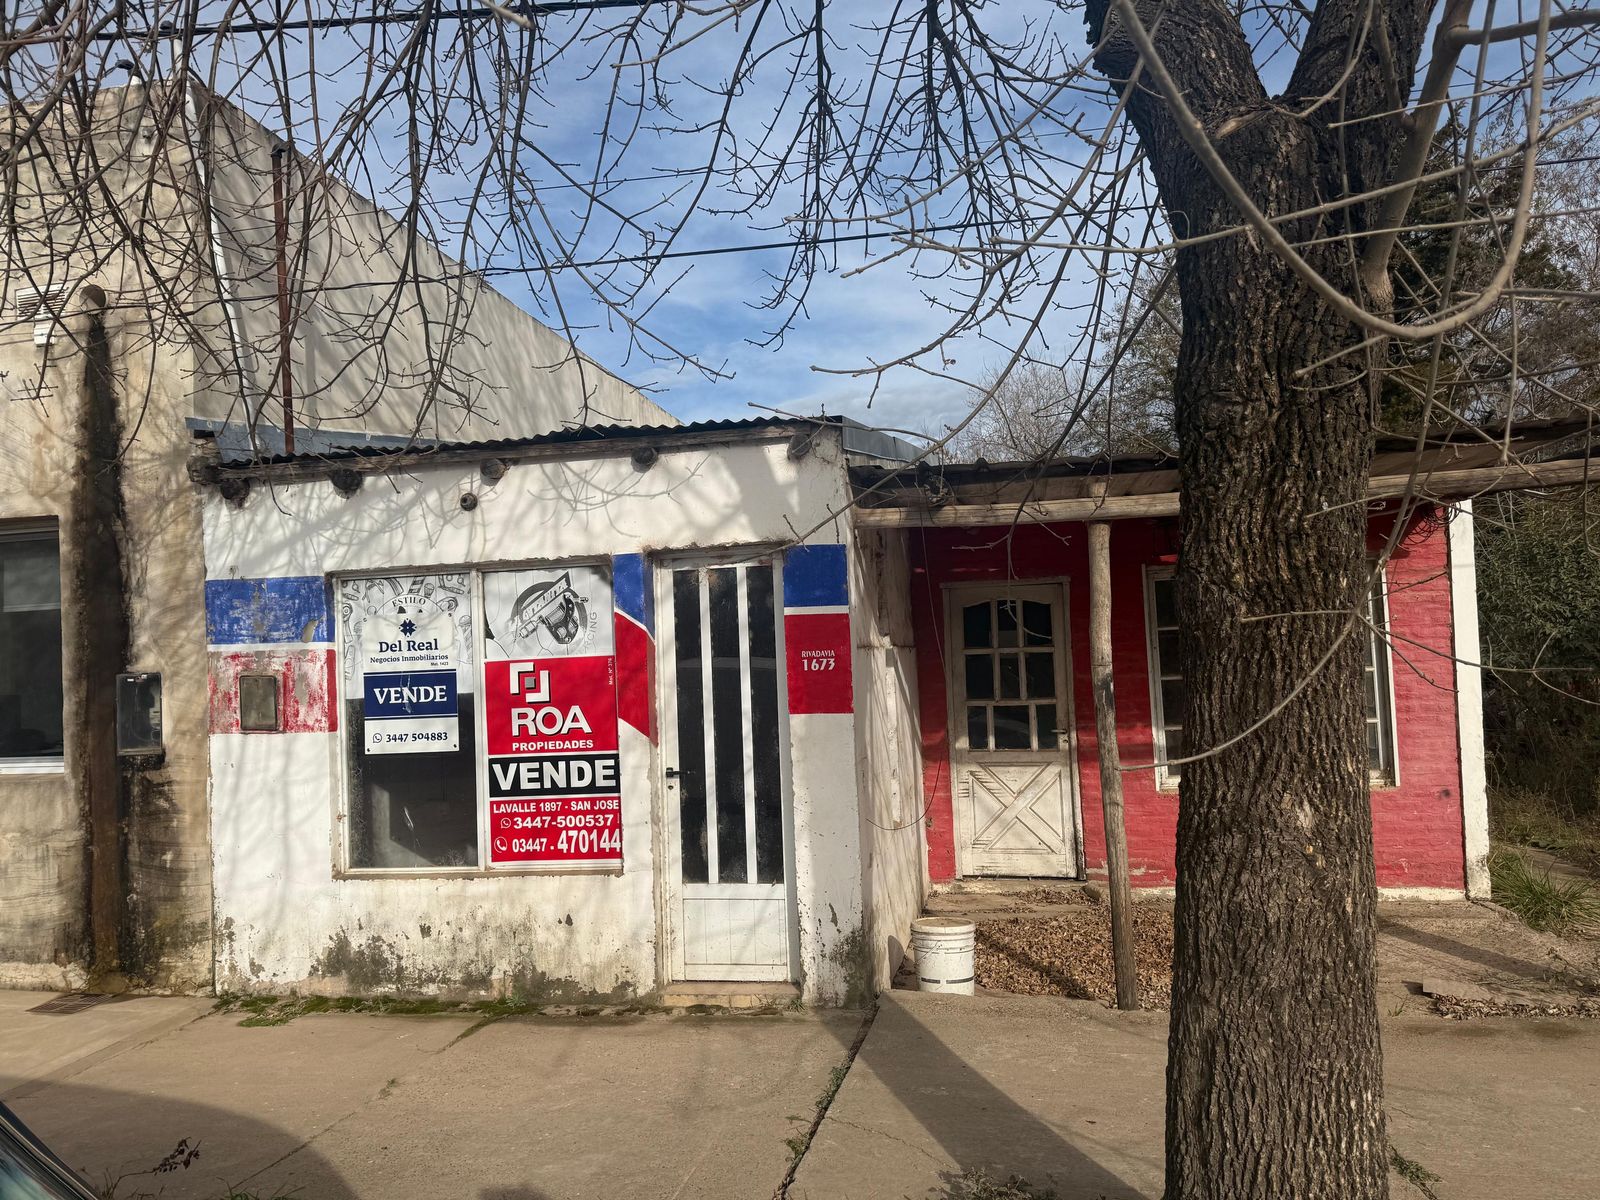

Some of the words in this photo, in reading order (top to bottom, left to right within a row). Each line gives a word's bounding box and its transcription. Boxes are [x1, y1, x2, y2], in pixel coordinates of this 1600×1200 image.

[391, 597, 426, 608] ESTILO
[379, 640, 402, 653] Del
[407, 638, 439, 652] Real
[370, 656, 400, 664] Negocios
[402, 654, 449, 662] Inmobiliarios
[801, 650, 836, 658] RIVADAVIA
[801, 658, 836, 671] 1673
[373, 685, 448, 705] VENDE
[511, 705, 593, 736] ROA
[386, 733, 409, 743] 3447
[411, 731, 448, 742] 504883
[512, 740, 594, 751] PROPIEDADES
[492, 759, 617, 791] VENDE
[493, 802, 537, 814] LAVALLE
[539, 801, 562, 812] 1897
[570, 800, 591, 811] SAN
[593, 799, 620, 810] JOSE
[513, 814, 614, 829] 3447-500537
[512, 837, 548, 853] 03447
[557, 828, 622, 854] 470144
